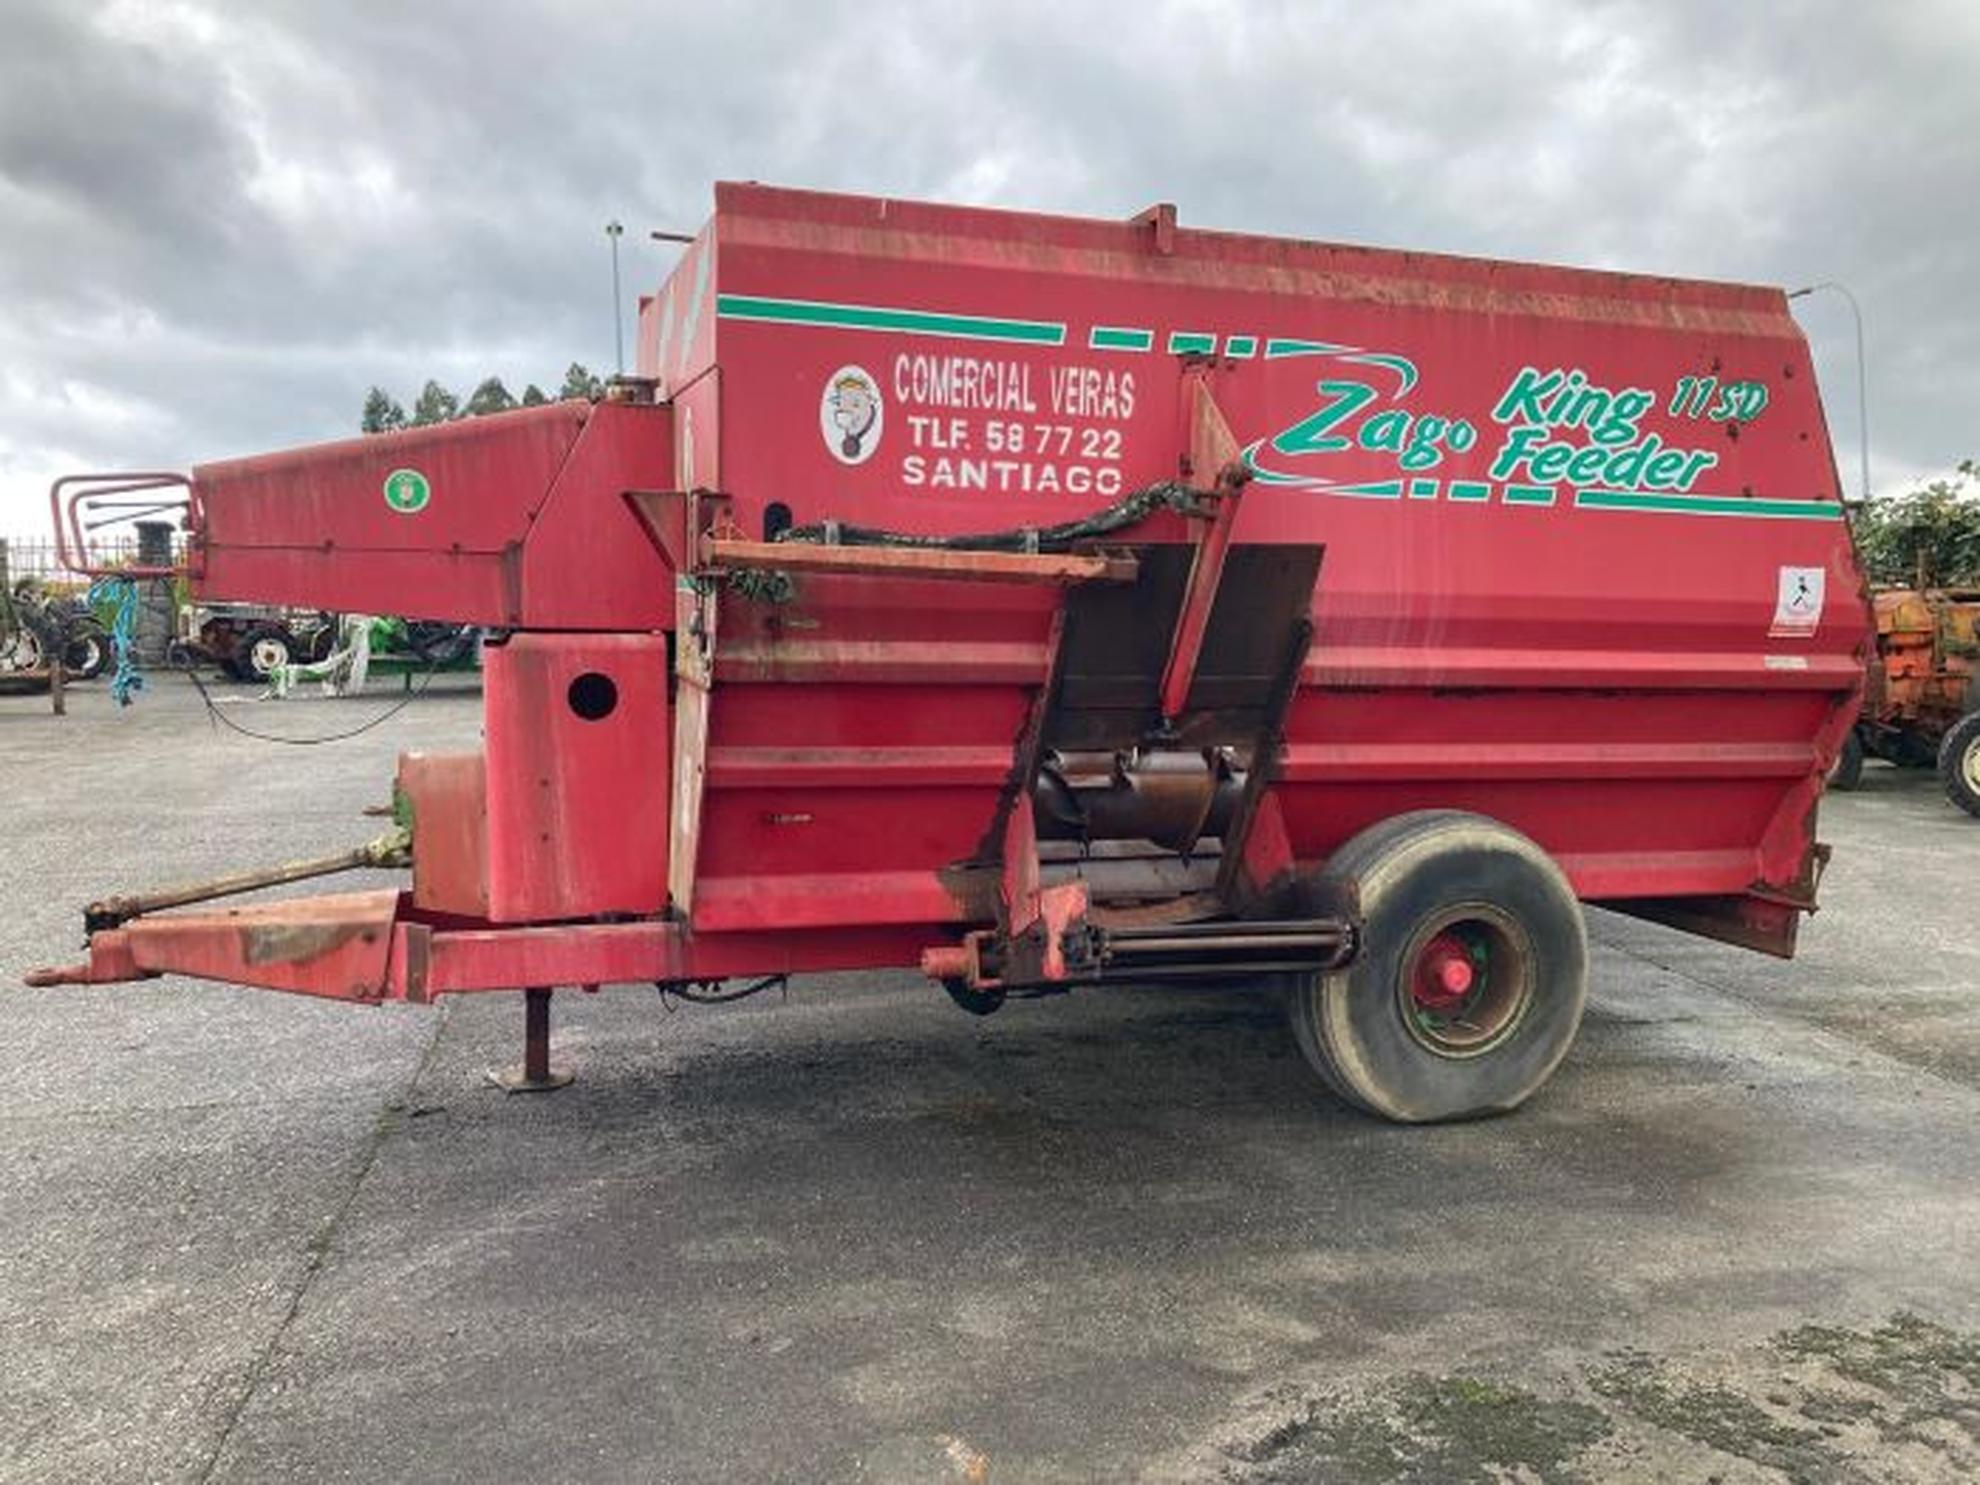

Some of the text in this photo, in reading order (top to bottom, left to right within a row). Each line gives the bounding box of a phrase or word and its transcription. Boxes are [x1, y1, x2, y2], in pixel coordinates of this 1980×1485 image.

[894, 353, 1135, 418] COMERCIAL VEIRAS
[1491, 367, 1655, 445] King
[985, 422, 1024, 452] 58
[1034, 425, 1073, 455] 77
[1081, 429, 1122, 459] 22
[1272, 379, 1478, 471] Zago
[902, 455, 1122, 495] SANTIAGO
[1489, 427, 1717, 490] Feeder
